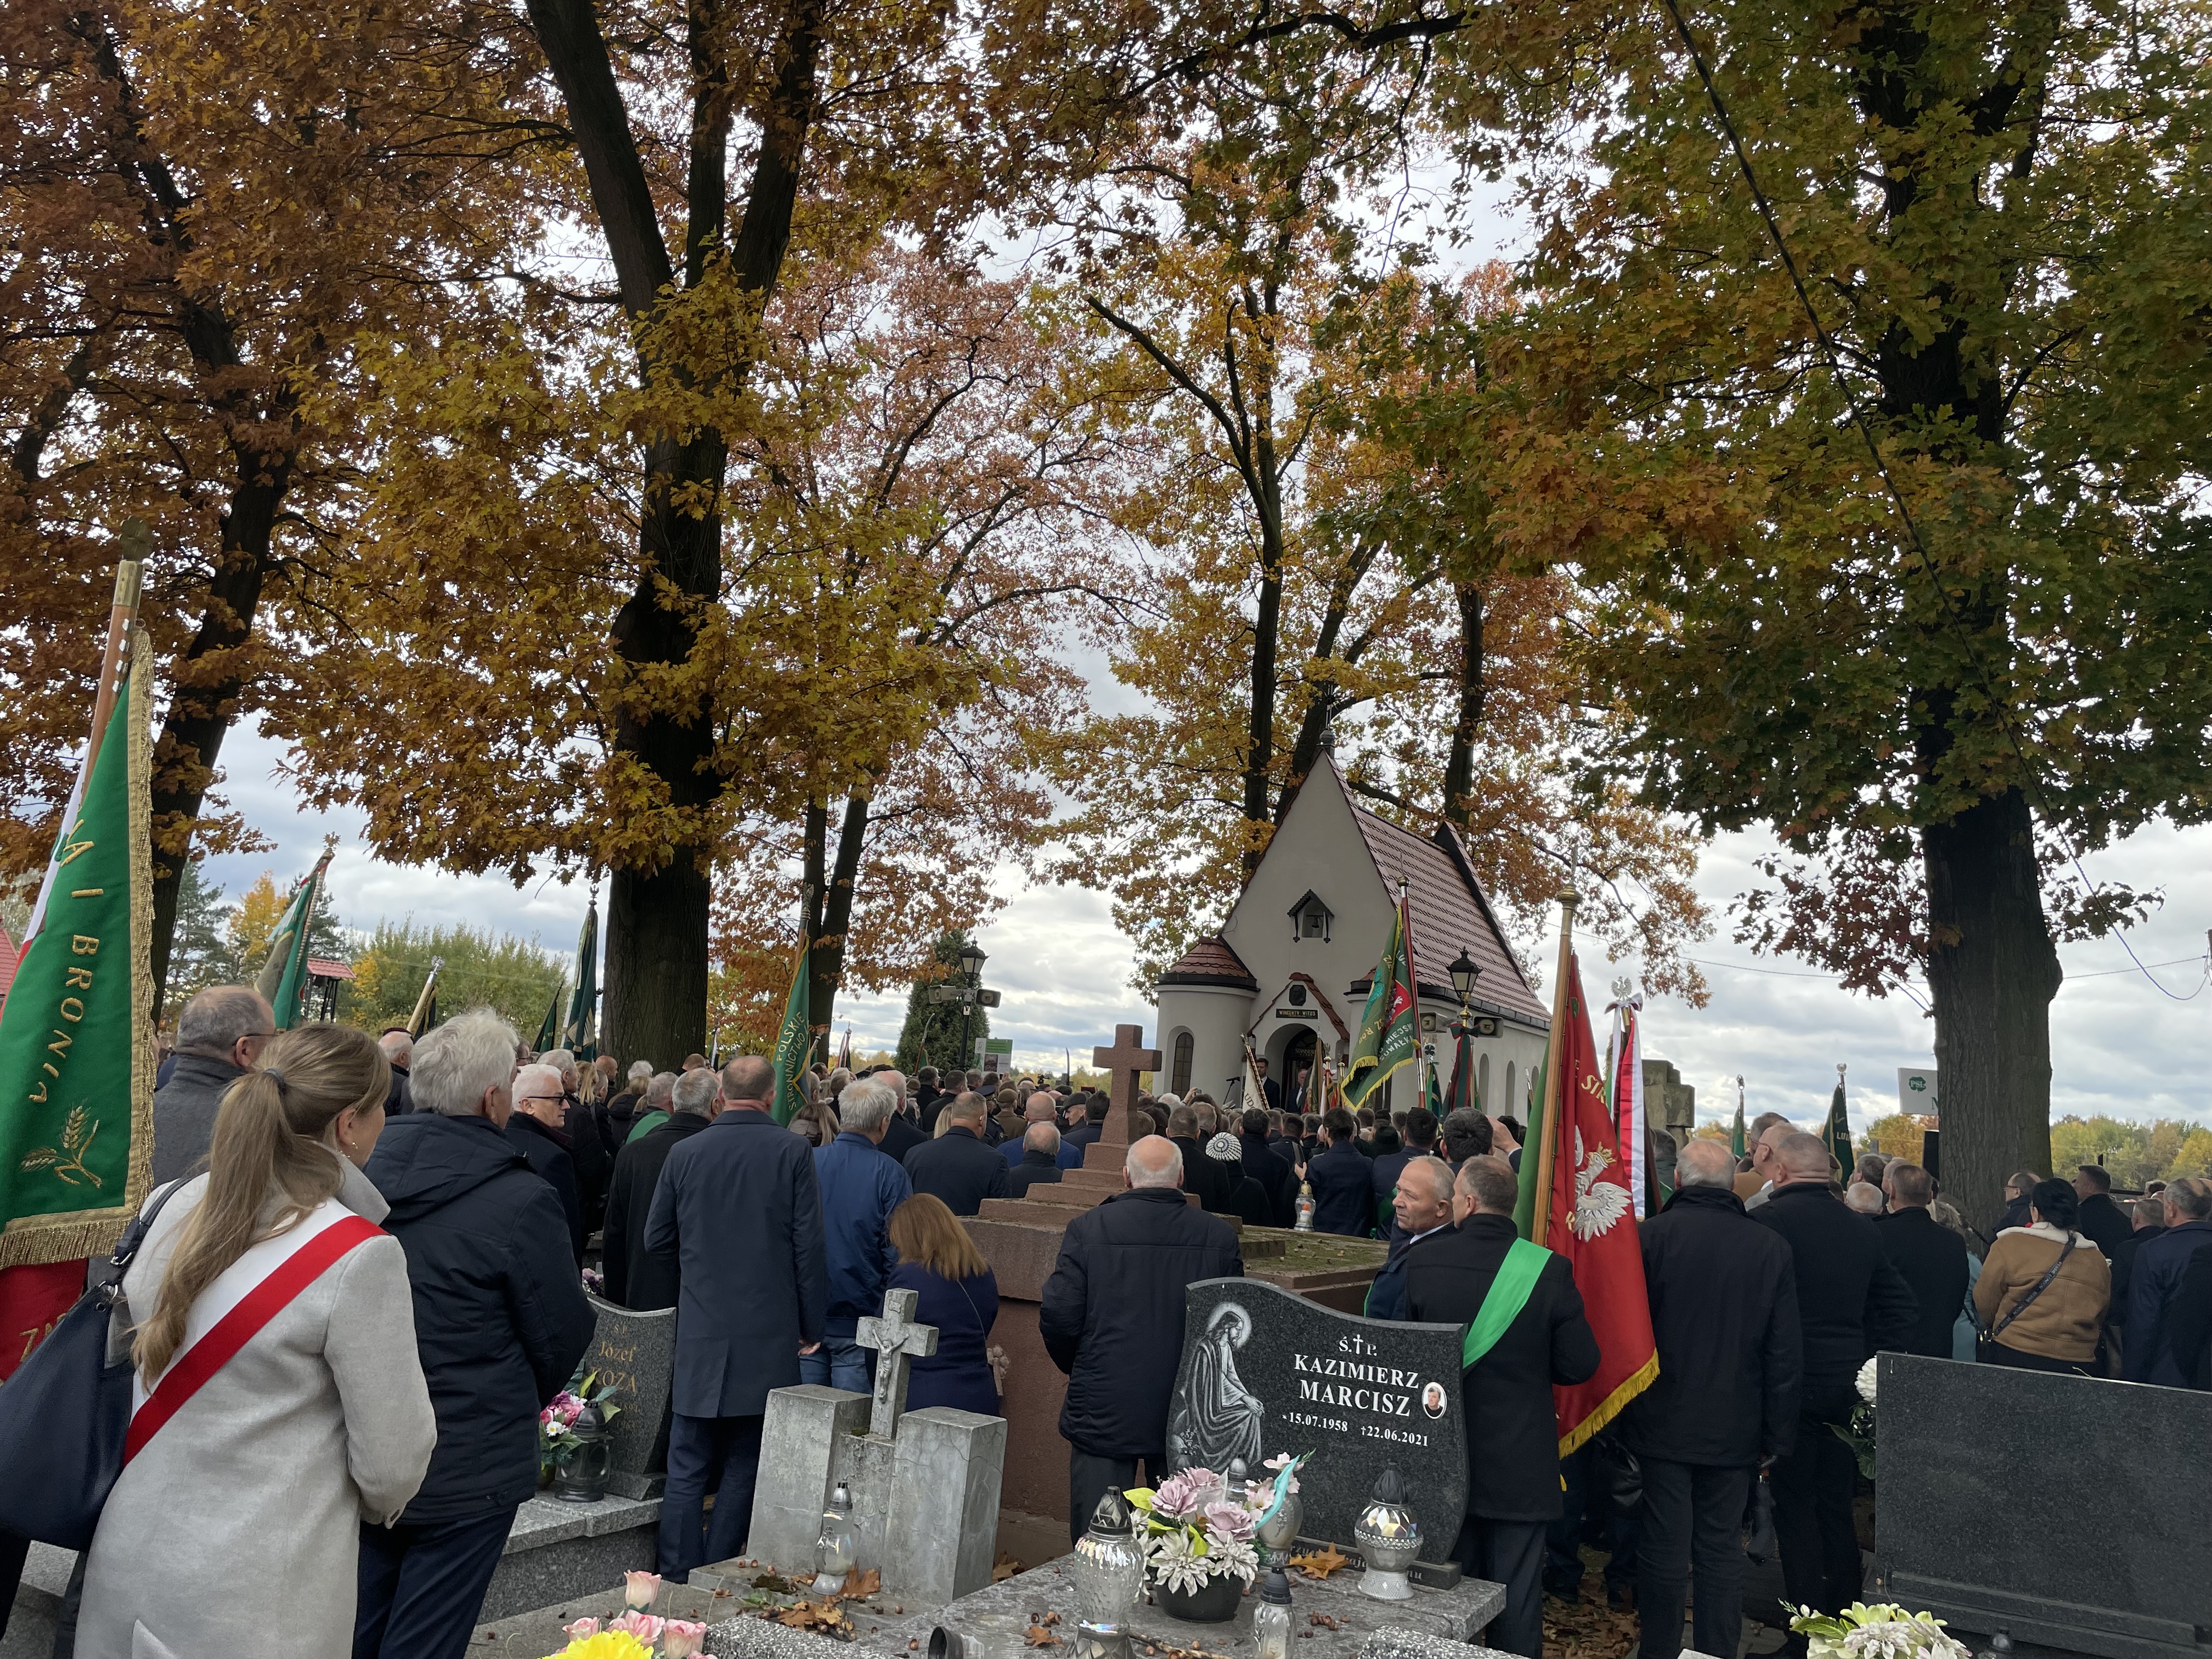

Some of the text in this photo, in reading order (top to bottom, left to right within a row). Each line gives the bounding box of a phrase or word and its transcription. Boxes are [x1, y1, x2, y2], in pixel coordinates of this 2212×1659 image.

[776, 1011, 805, 1062] POLSKIE
[785, 1032, 806, 1111] STRONNICTWO
[1910, 1080, 1926, 1088] PSL
[599, 1340, 637, 1362] Józef
[1294, 1353, 1420, 1389] KAZIMIERZ
[1299, 1379, 1411, 1417] MARCISZ
